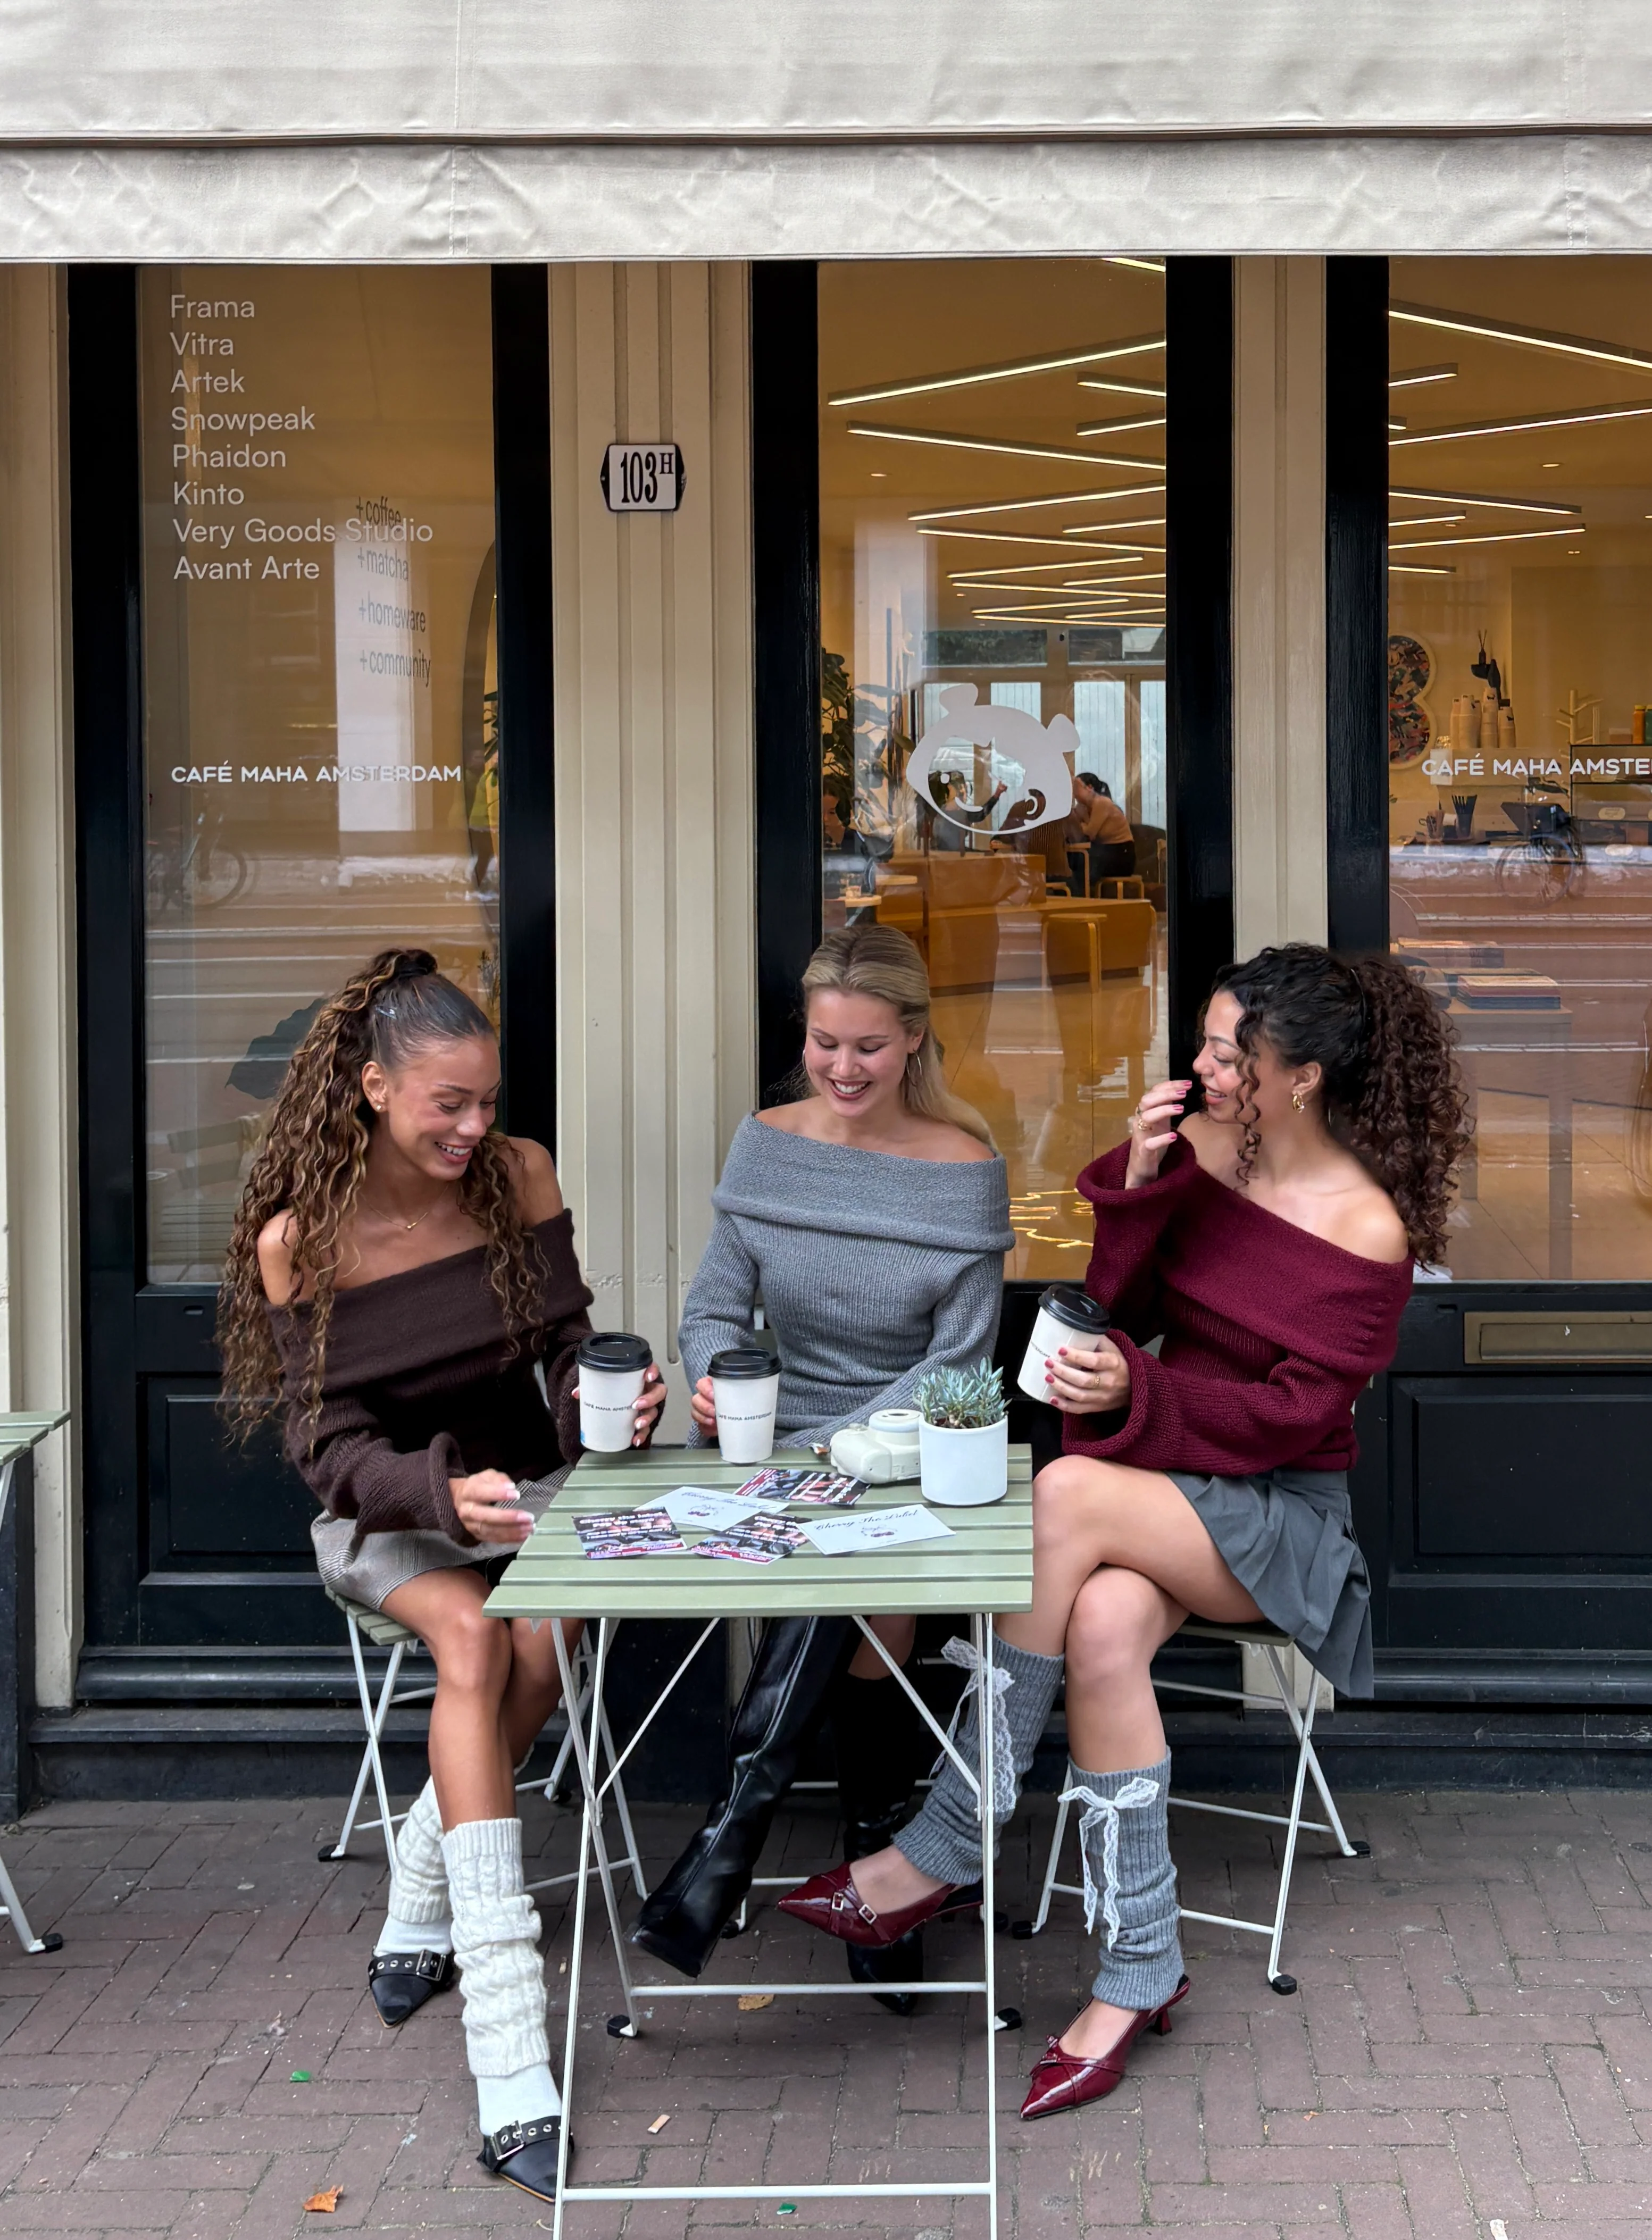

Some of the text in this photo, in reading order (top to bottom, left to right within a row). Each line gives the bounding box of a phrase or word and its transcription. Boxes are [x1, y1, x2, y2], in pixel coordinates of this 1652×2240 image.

[171, 294, 255, 319] Frama
[170, 331, 234, 356] Vitra
[170, 368, 245, 394] Artek
[171, 406, 315, 436] Snowpeak
[172, 444, 286, 467] Phaidon
[173, 481, 245, 505] Kinto
[173, 517, 433, 549] Very Goods Studio
[173, 556, 320, 580] Avant Arte
[171, 760, 462, 783] CAFÉ MAHA AMSTERDAM
[1422, 753, 1652, 776] CAFÉ MAHA AMSTE
